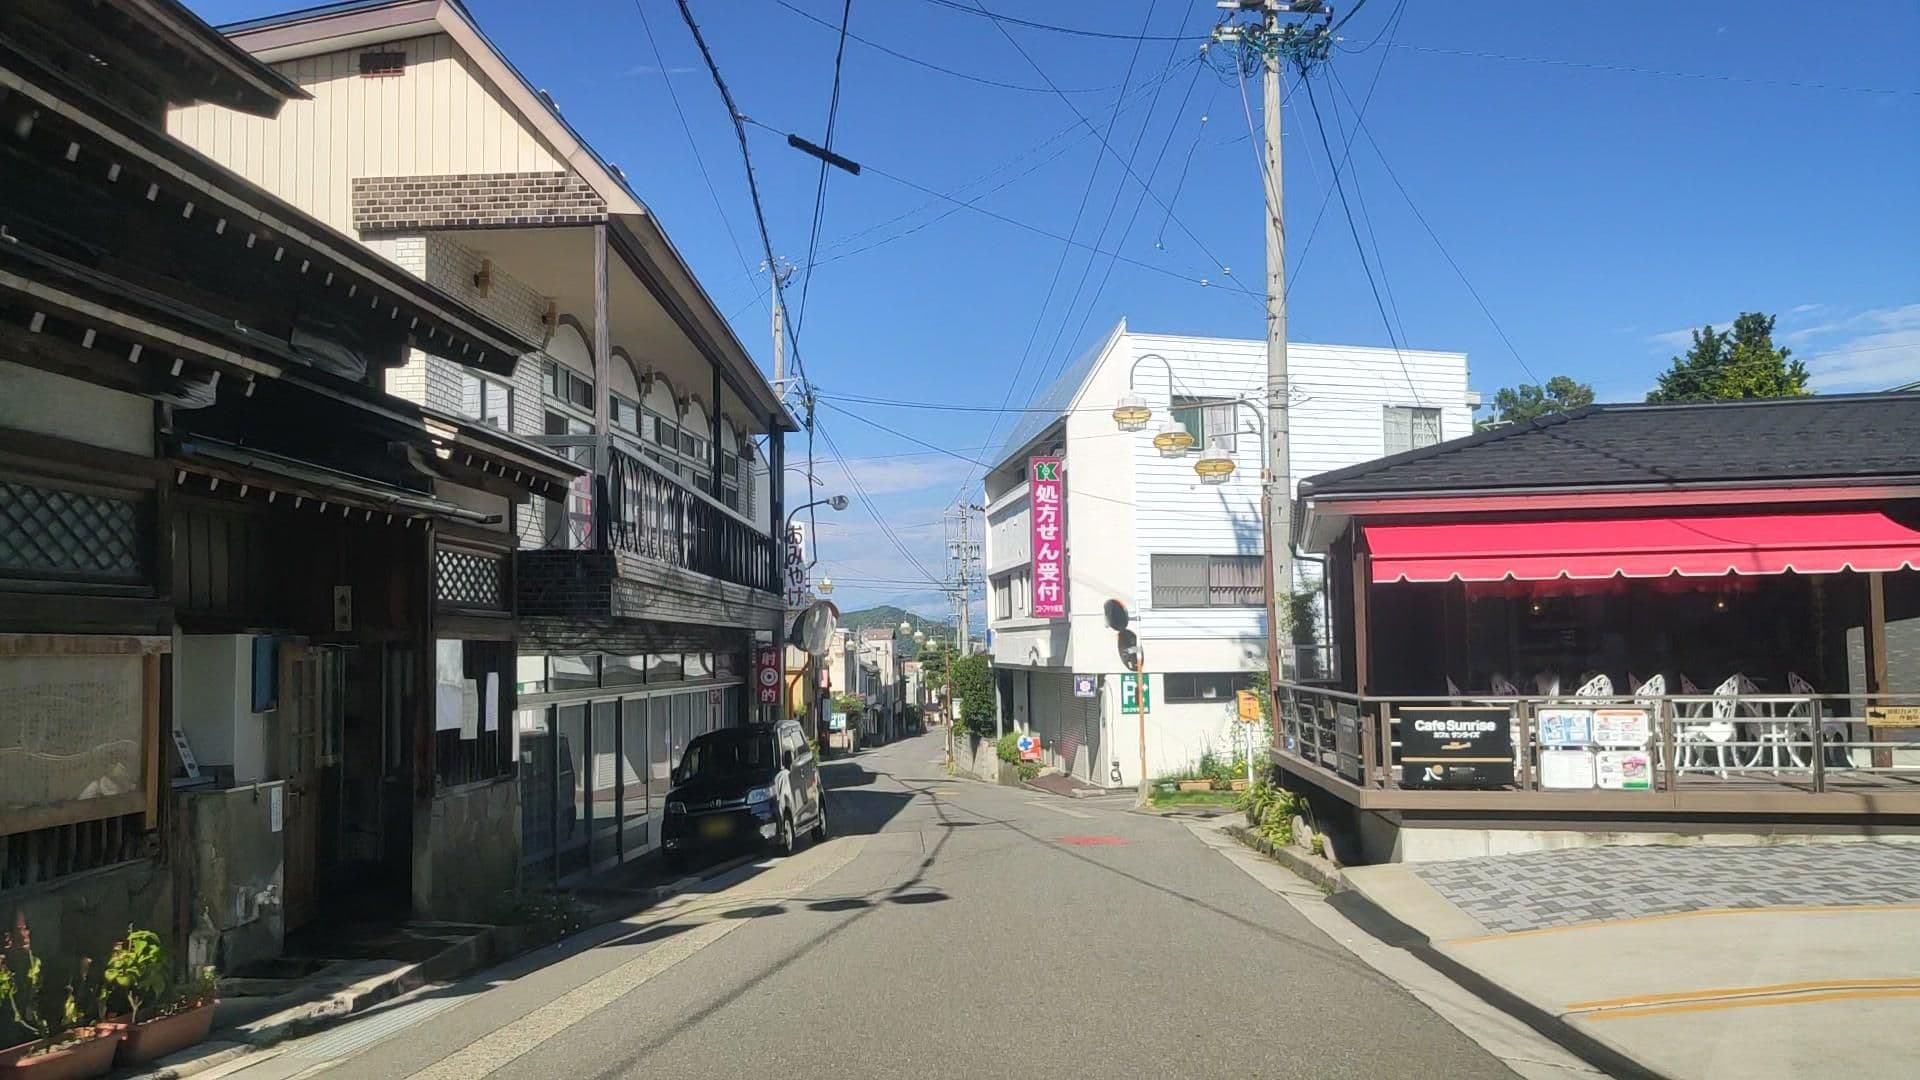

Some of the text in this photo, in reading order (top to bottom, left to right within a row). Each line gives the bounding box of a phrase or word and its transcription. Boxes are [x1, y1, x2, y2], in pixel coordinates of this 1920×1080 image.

[1036, 484, 1060, 602] 処方せん受付
[1123, 681, 1138, 704] P
[1414, 719, 1497, 732] Cafe Sunrise
